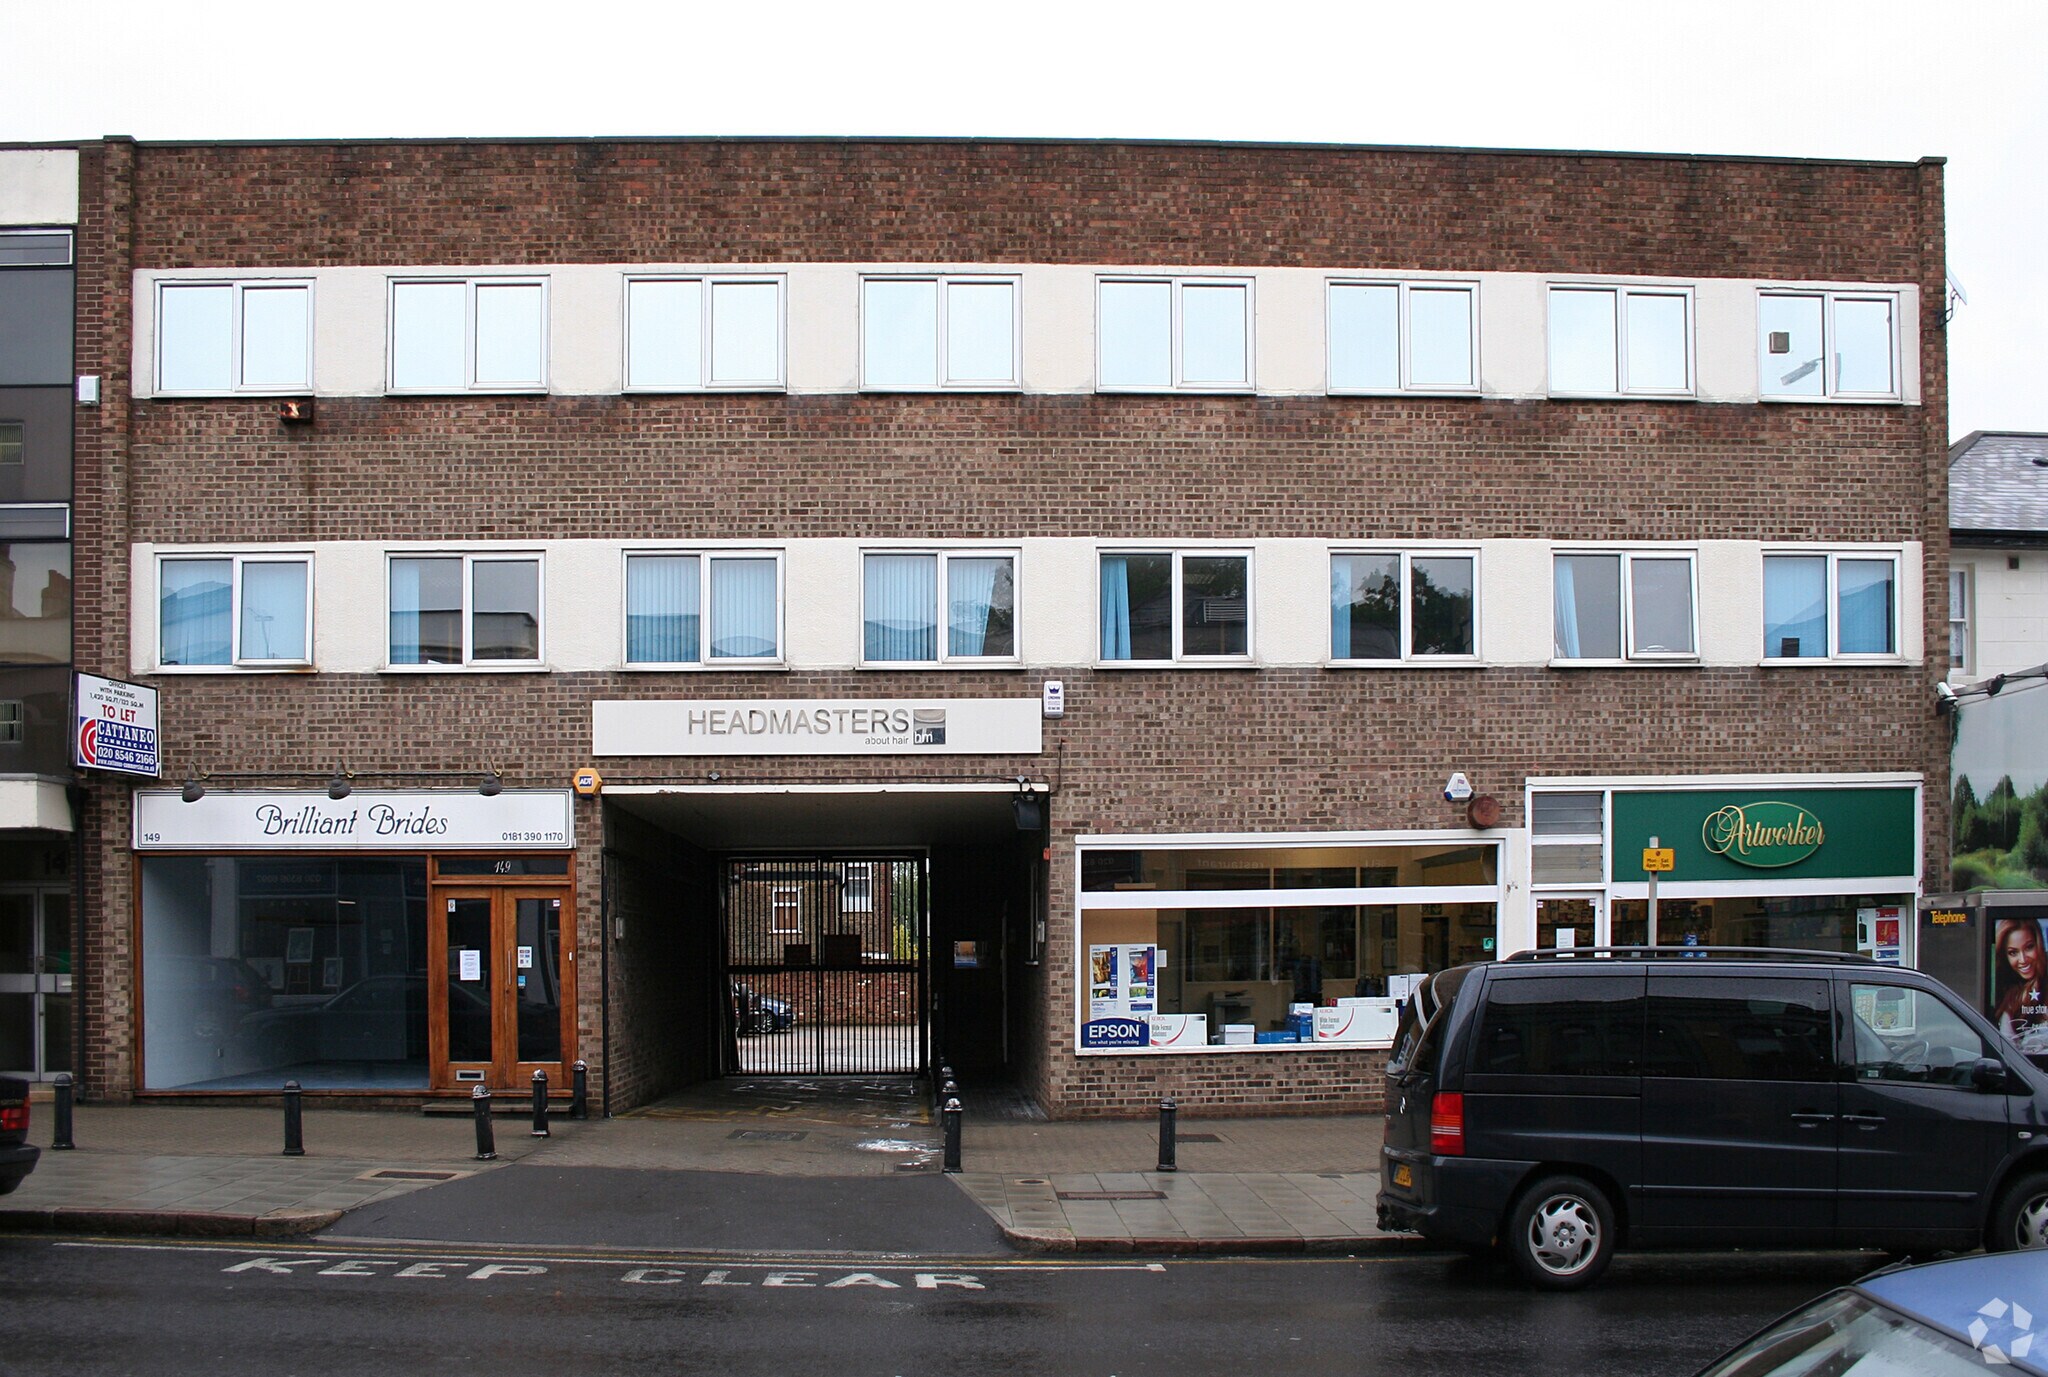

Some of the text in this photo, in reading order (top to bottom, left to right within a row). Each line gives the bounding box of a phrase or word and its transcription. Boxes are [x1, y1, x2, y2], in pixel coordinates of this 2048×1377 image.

[108, 681, 127, 690] OFFICES
[114, 689, 135, 699] PARKING
[102, 704, 136, 723] TO LET
[688, 709, 909, 735] HEADMASTERS
[98, 721, 155, 744] CATTANEO
[865, 735, 909, 745] about hair
[98, 736, 154, 751] COMMERCIAL
[98, 747, 155, 765] 020 8546 2166
[256, 804, 448, 835] Brilliant Brides
[144, 833, 161, 841] 149
[502, 832, 563, 841] 0181 390 1170
[1702, 805, 1825, 855] Artworker
[495, 861, 511, 873] 149
[1930, 910, 1967, 926] Telephone
[2021, 1004, 2047, 1014] true star
[1089, 1025, 1140, 1038] EPSON
[220, 1257, 548, 1280] KEEP
[620, 1268, 986, 1290] CLEAR
